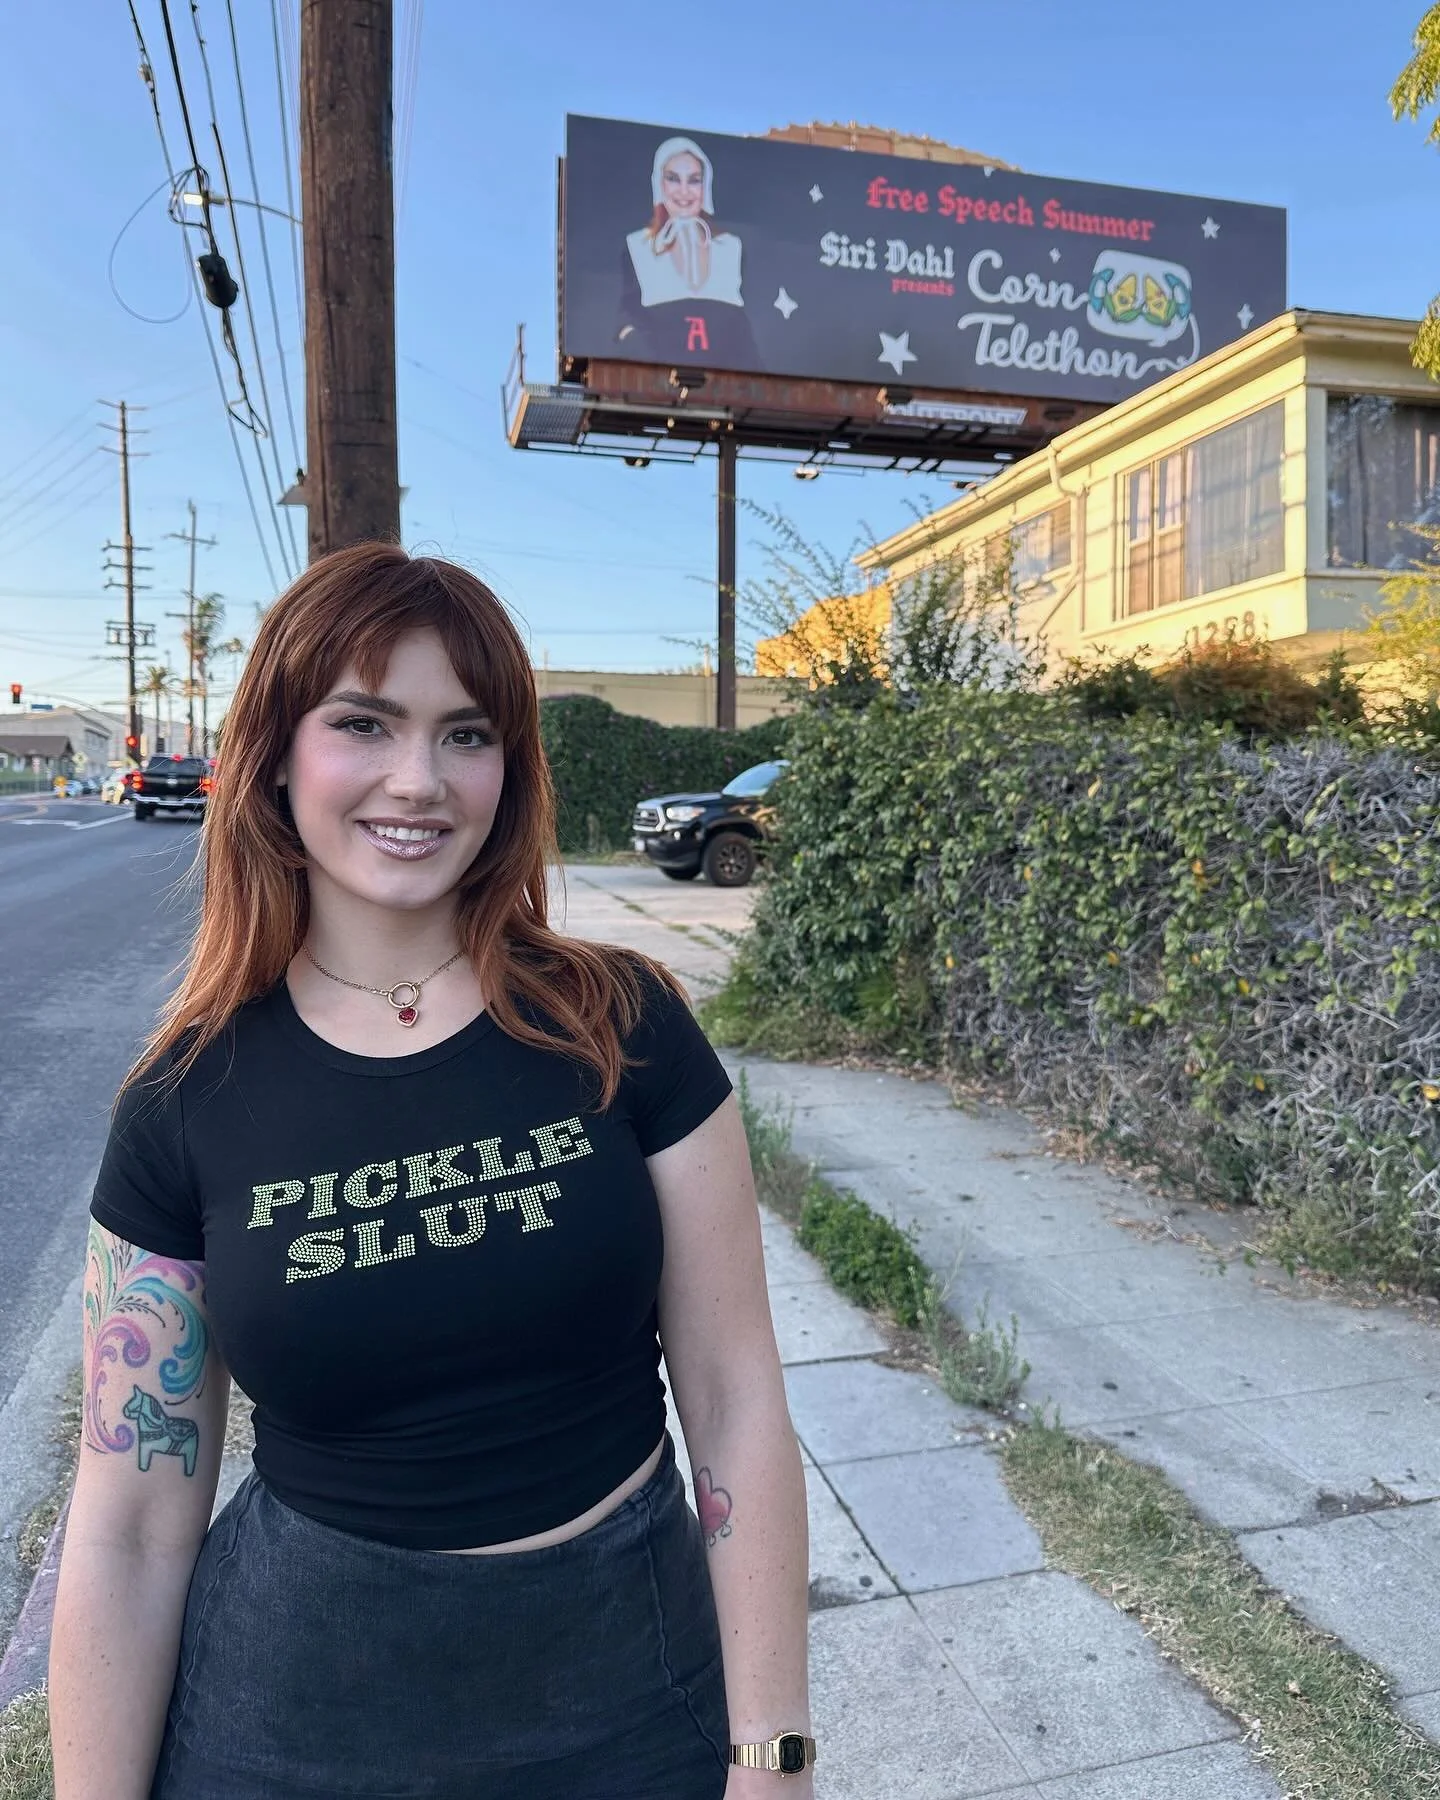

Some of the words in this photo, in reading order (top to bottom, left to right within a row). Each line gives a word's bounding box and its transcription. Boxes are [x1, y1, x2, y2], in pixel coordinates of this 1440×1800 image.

[866, 176, 929, 213] Free
[938, 184, 1034, 225] Speech
[1042, 199, 1155, 241] Summer
[819, 231, 877, 271] Siri
[884, 239, 956, 279] Dahl
[967, 249, 1089, 311] Corn
[891, 277, 956, 297] presents
[684, 316, 709, 350] A
[957, 312, 1157, 380] Telethon
[247, 1116, 594, 1230] PICKLE
[285, 1181, 562, 1285] SLUT
